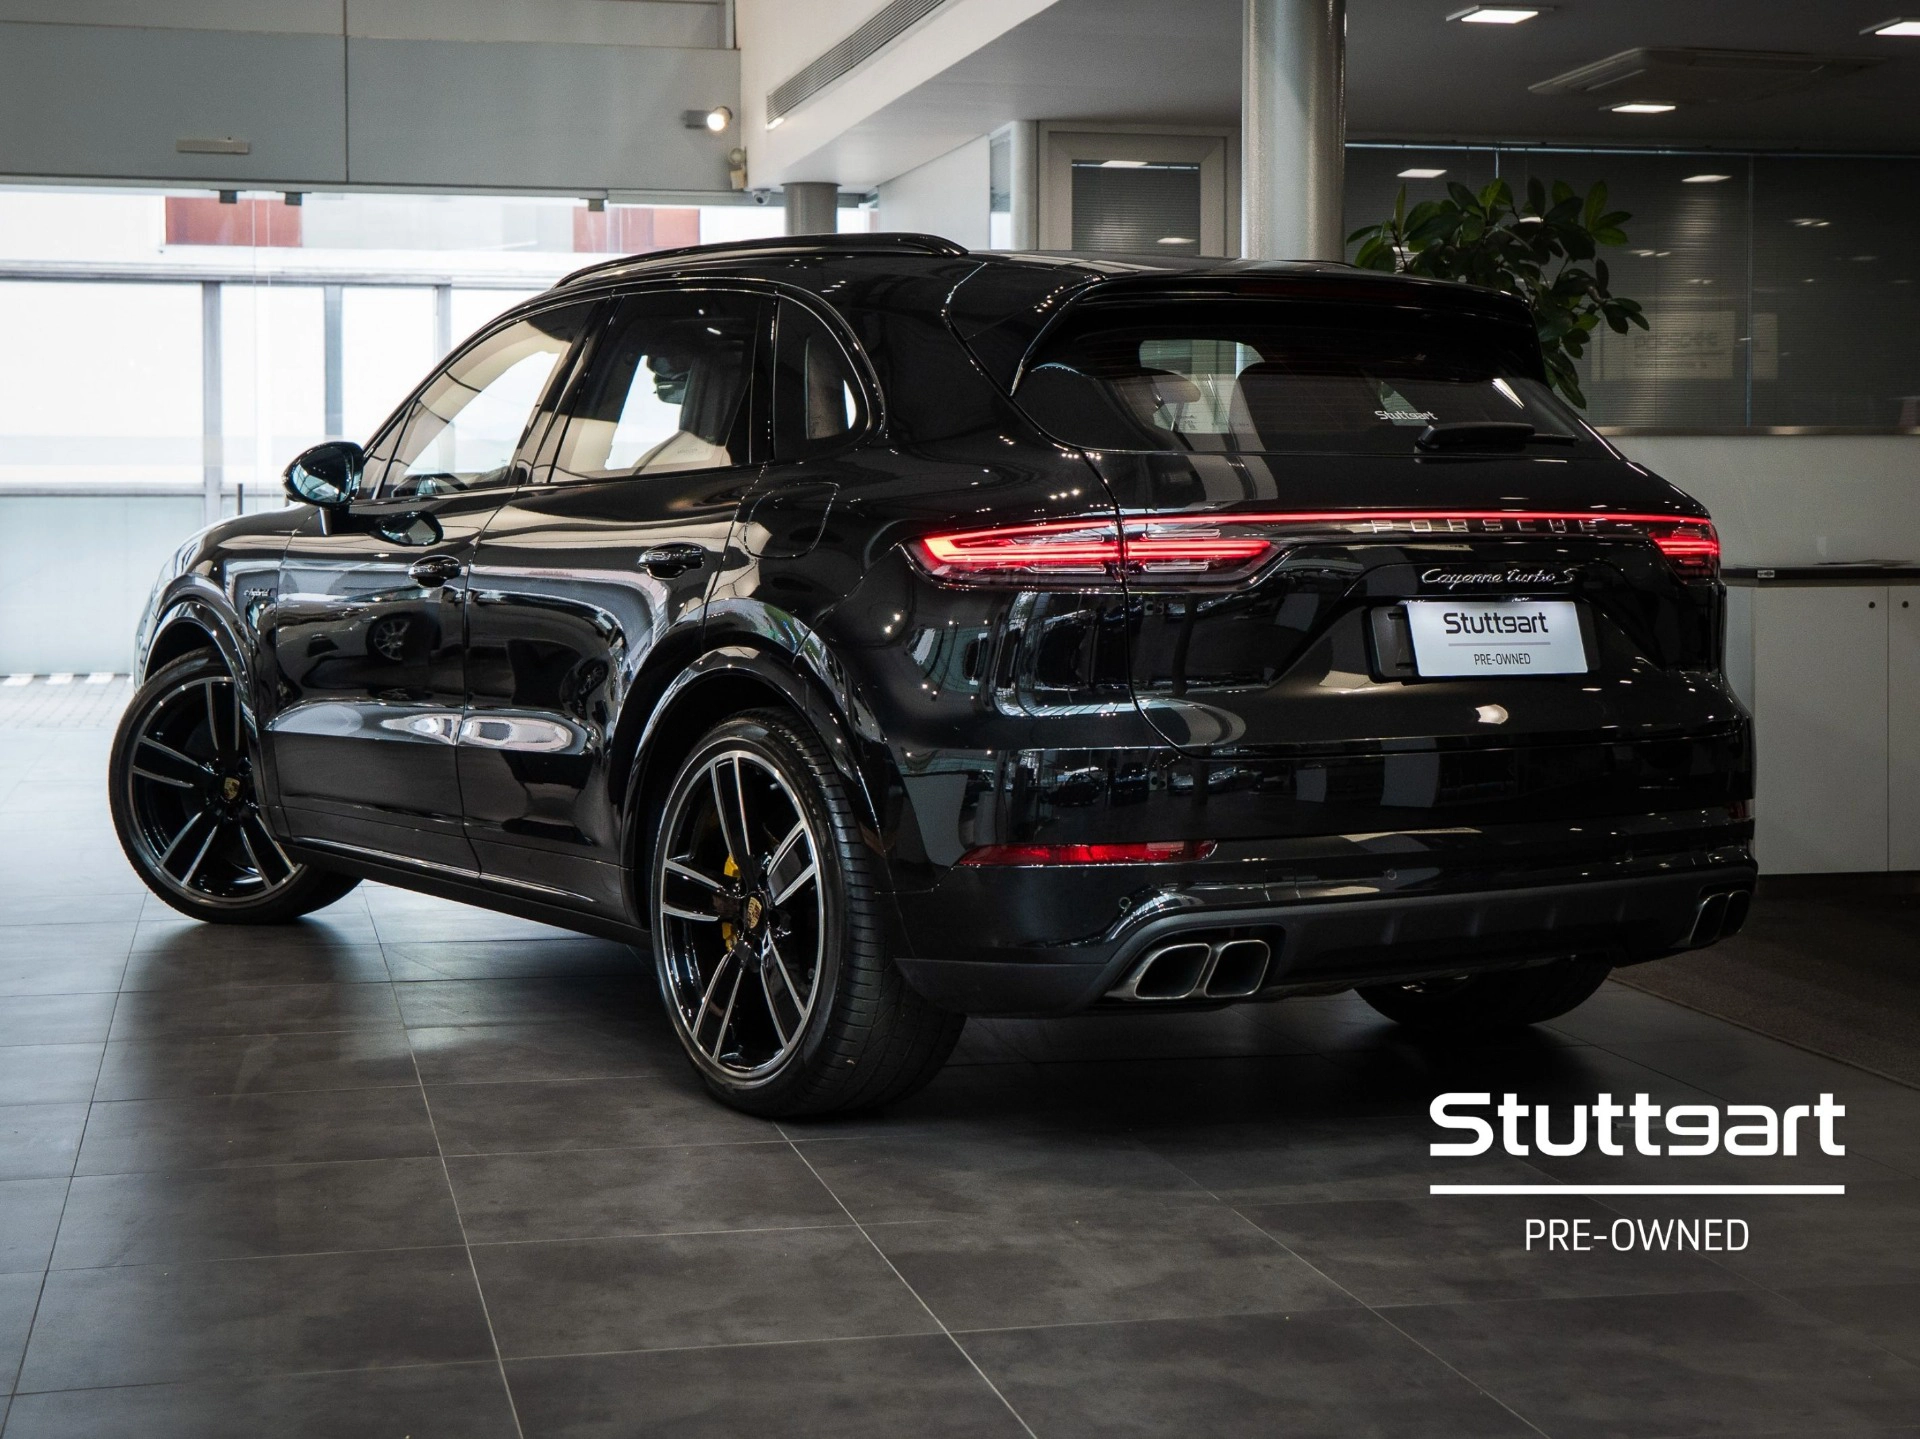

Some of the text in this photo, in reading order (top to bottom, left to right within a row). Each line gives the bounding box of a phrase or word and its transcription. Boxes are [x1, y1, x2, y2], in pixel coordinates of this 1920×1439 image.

[1374, 410, 1438, 420] Stuttgart
[1371, 519, 1599, 533] PORSCHE
[1421, 568, 1503, 590] Cayenne
[1554, 568, 1578, 585] S
[1443, 612, 1549, 635] Stuttgart
[1473, 653, 1531, 666] PRE-OWNED
